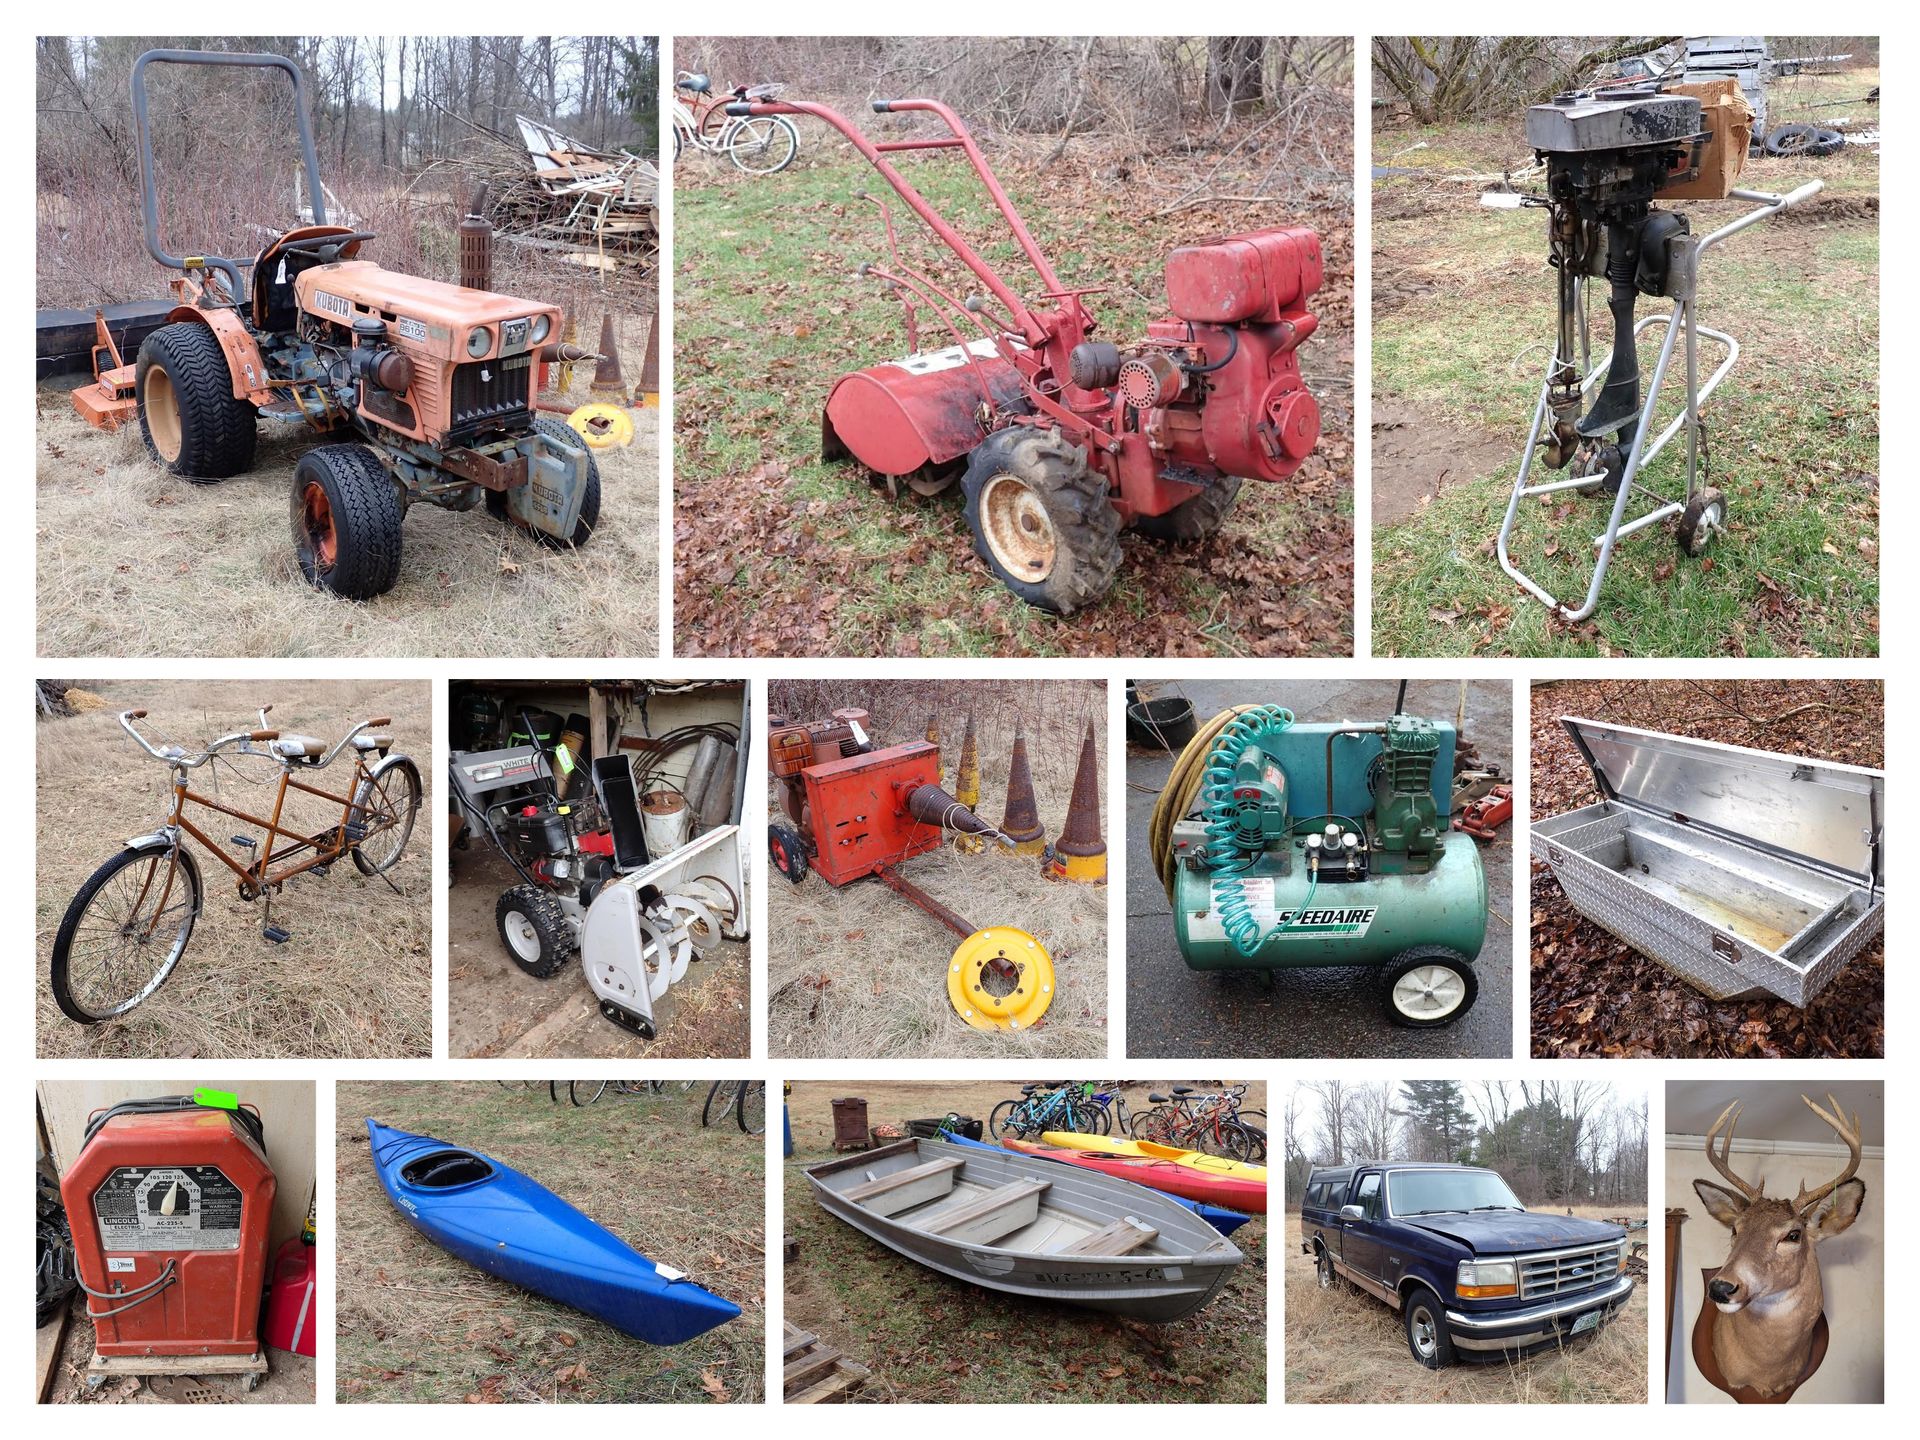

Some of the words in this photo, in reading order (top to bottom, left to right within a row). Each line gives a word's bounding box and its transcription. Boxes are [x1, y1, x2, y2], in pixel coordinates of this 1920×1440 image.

[316, 291, 350, 317] KUBOTA
[503, 757, 530, 769] WHITE
[1277, 909, 1375, 925] SPEEDAIRE
